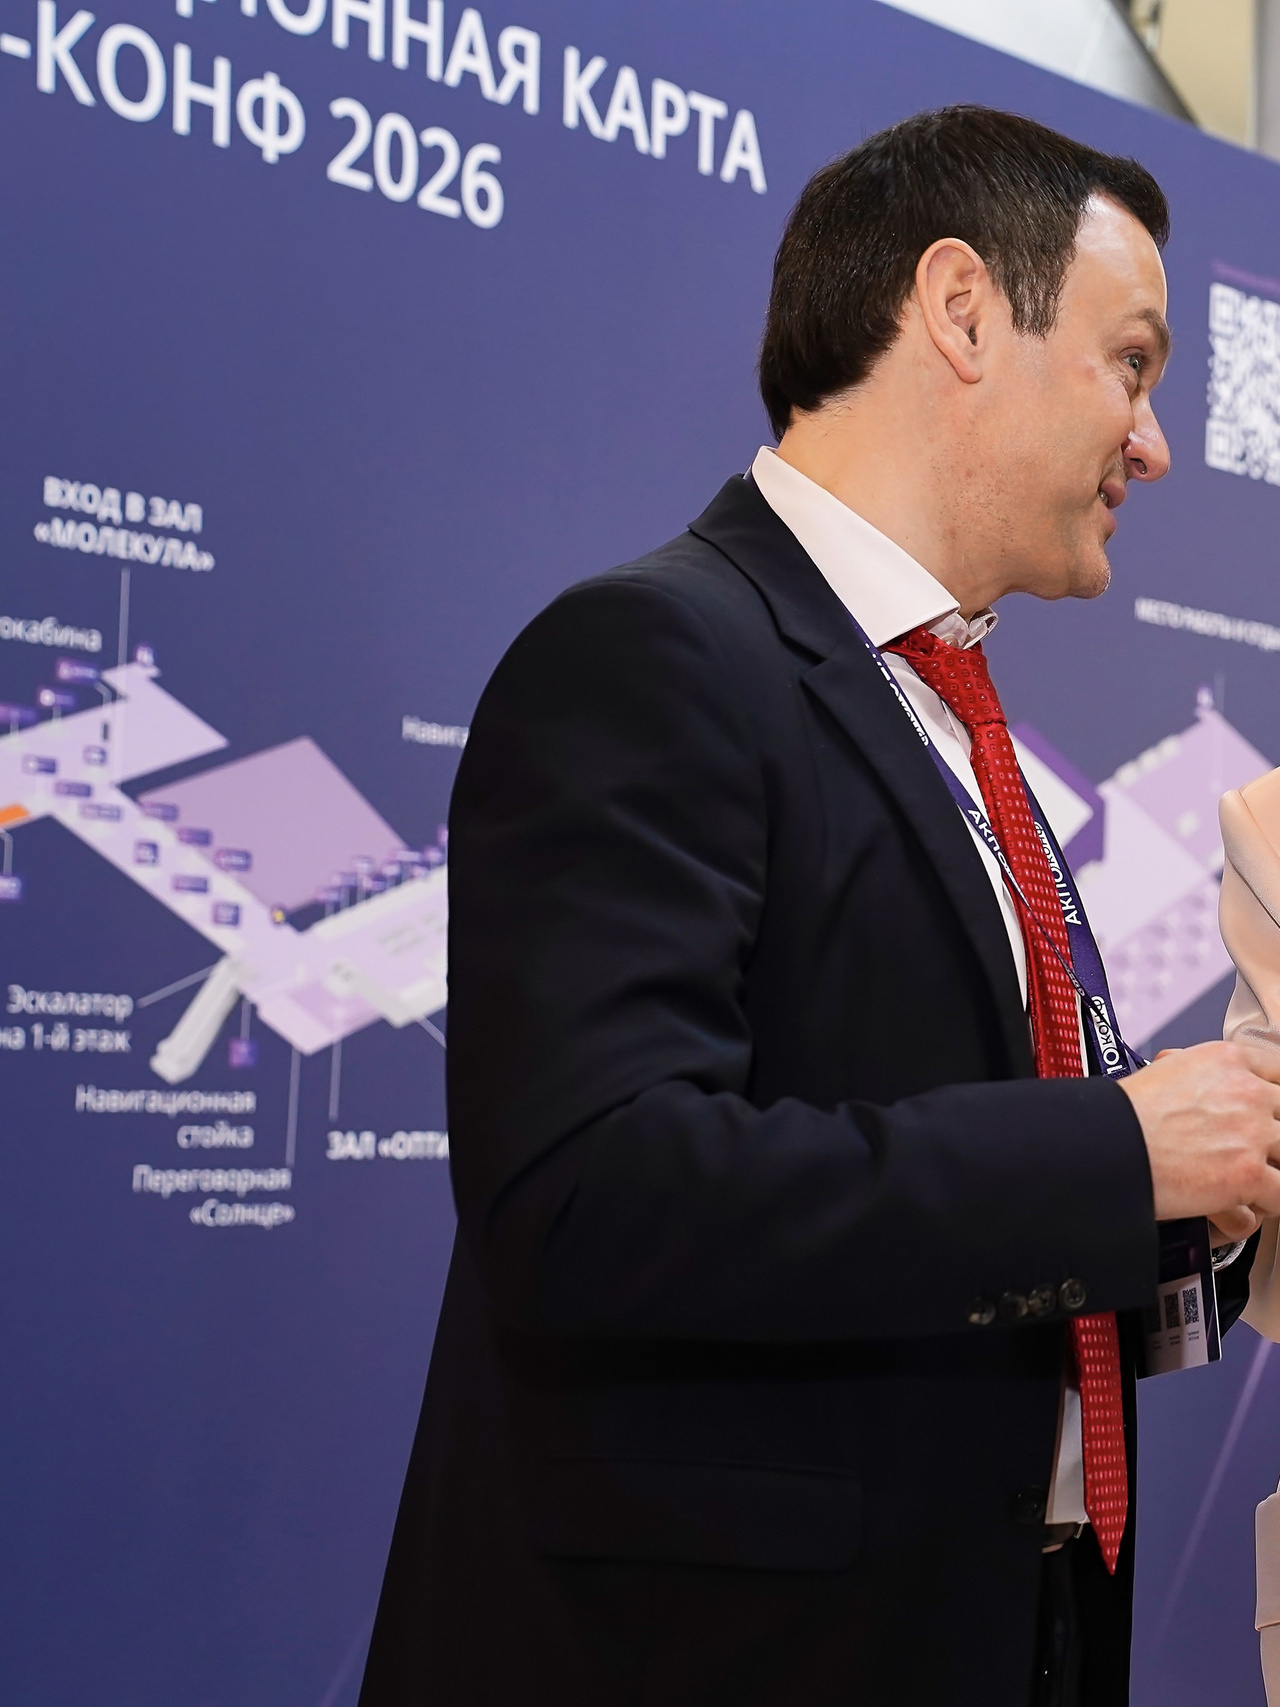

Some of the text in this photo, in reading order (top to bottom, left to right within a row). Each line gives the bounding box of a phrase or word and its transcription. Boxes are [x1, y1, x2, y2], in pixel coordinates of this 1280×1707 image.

[327, 97, 503, 230] 2026
[563, 46, 768, 194] КАРТА
[43, 475, 203, 534] ВХОД В ЗАЛ
[325, 1130, 449, 1160] ЗАЛ «ОПТИ
